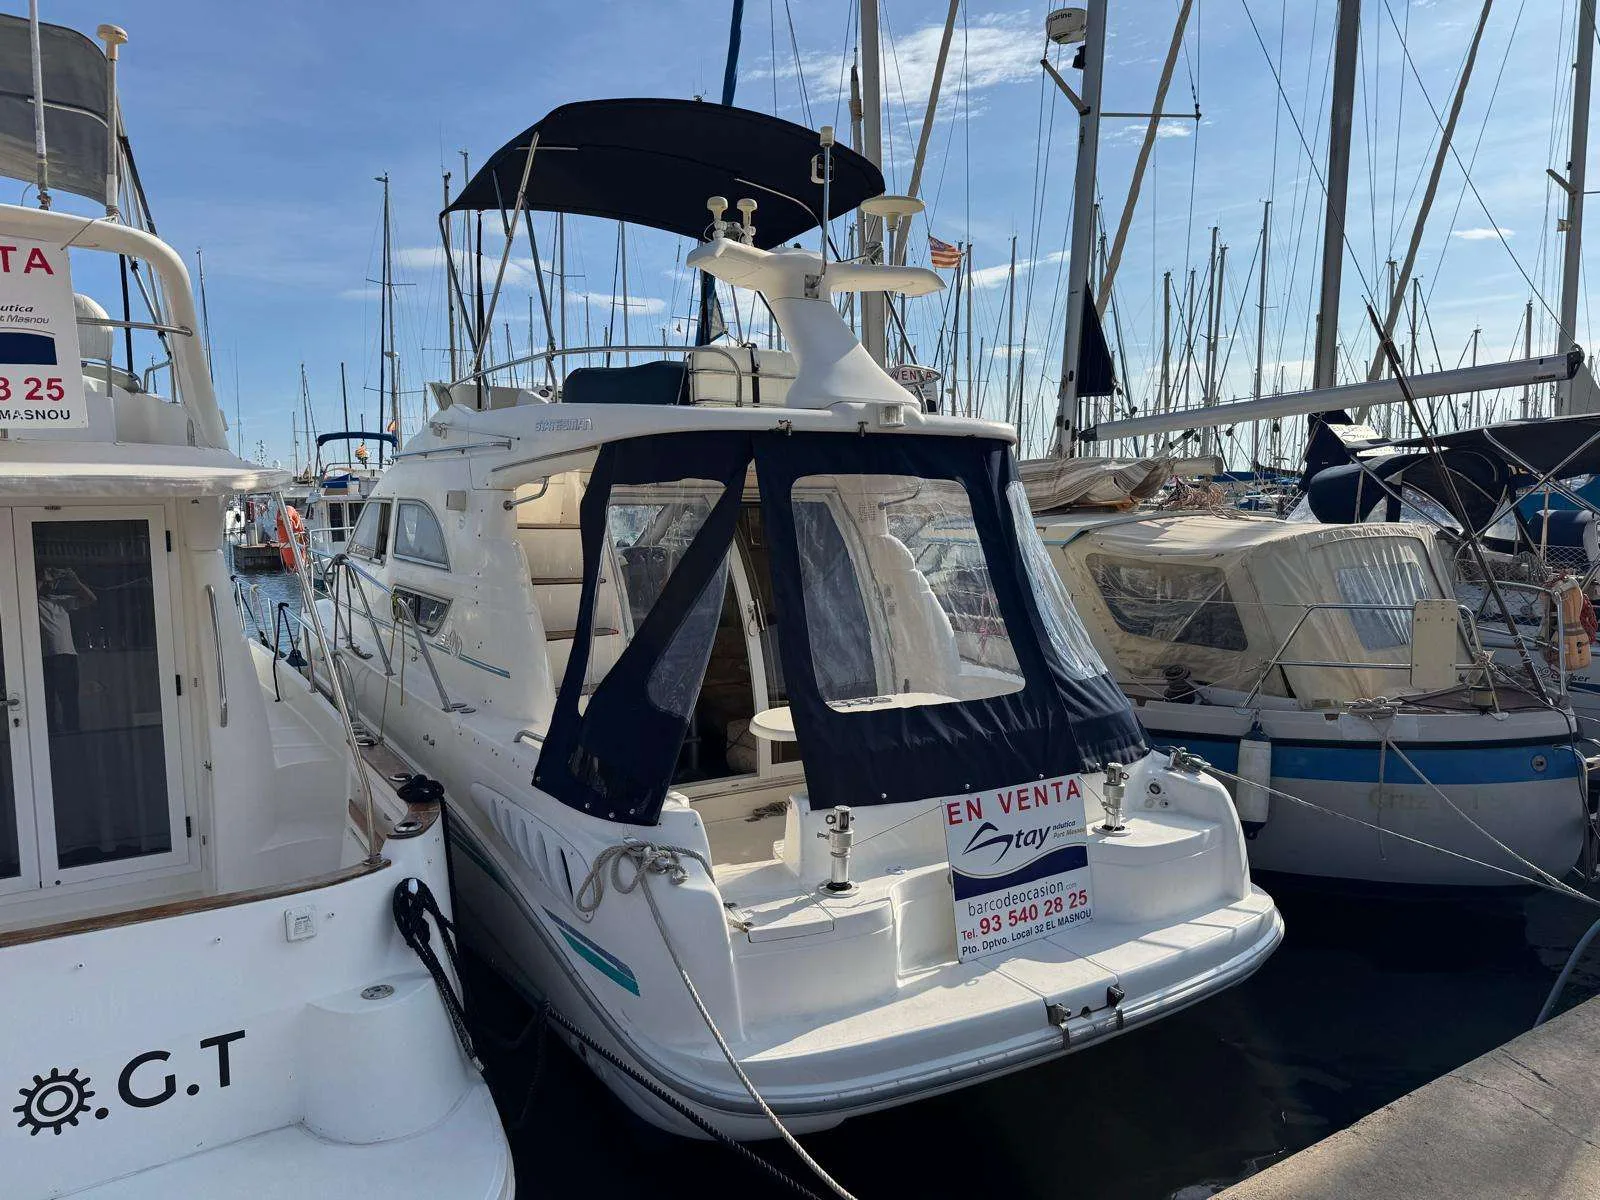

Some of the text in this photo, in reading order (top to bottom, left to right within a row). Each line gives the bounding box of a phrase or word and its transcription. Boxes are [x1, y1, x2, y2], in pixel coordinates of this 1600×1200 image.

[7, 315, 50, 324] Masnou
[24, 377, 65, 402] 25
[0, 409, 71, 420] MASNOU
[946, 779, 1081, 826] EN VENTA
[962, 822, 1052, 865] Stay
[961, 889, 1088, 941] Tel. 93 540 28 25
[962, 908, 1092, 956] Pto. Dptvo. Local 32 EL MASNOU
